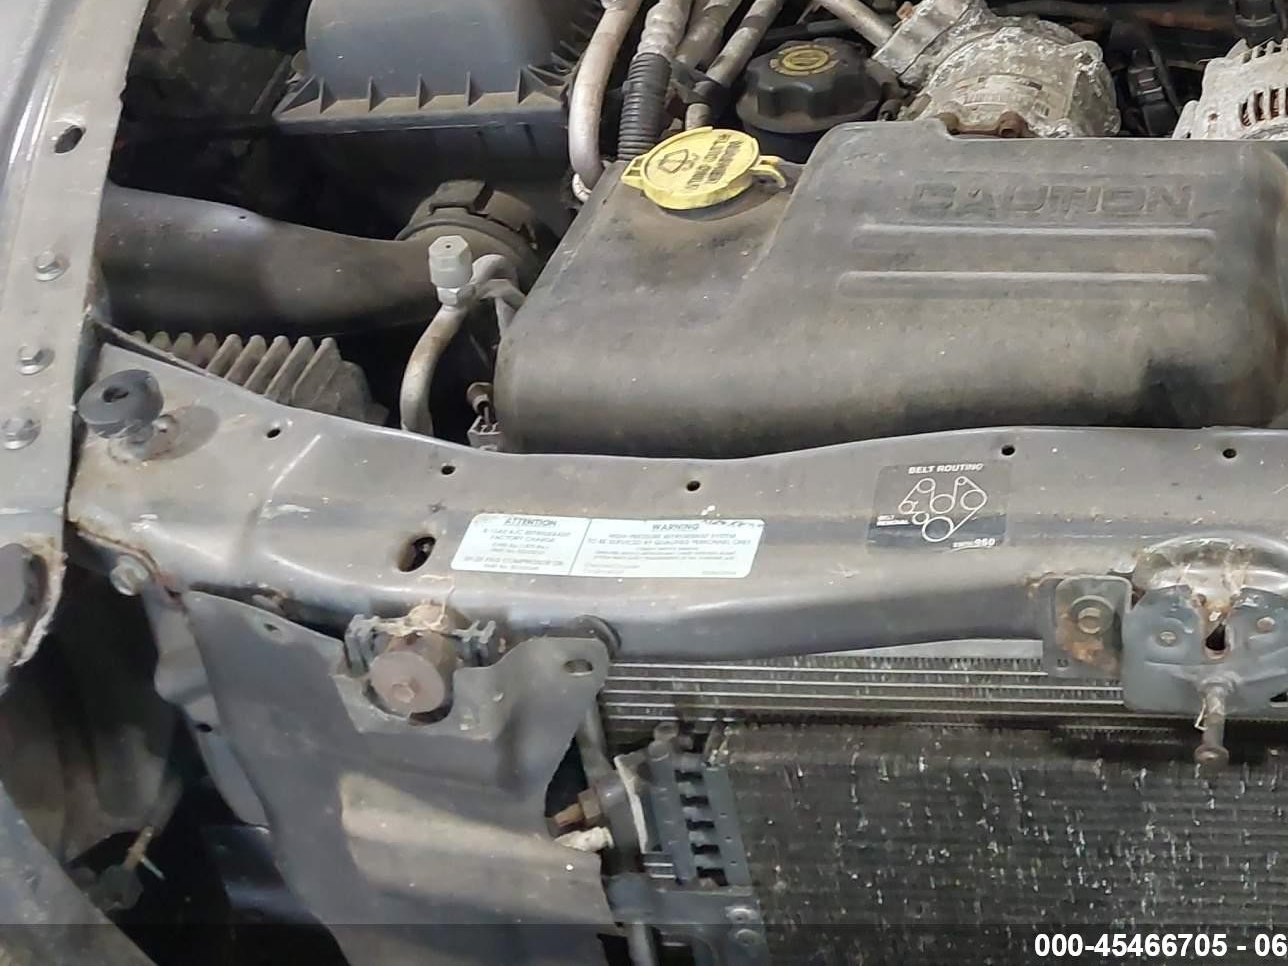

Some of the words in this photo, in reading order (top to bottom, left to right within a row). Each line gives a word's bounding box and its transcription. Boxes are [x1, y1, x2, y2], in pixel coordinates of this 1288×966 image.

[908, 181, 1196, 220] CAUTION
[907, 465, 936, 474] BELT
[936, 463, 985, 473] ROUTING
[503, 516, 559, 527] ATTENTION
[651, 522, 700, 531] WARNING
